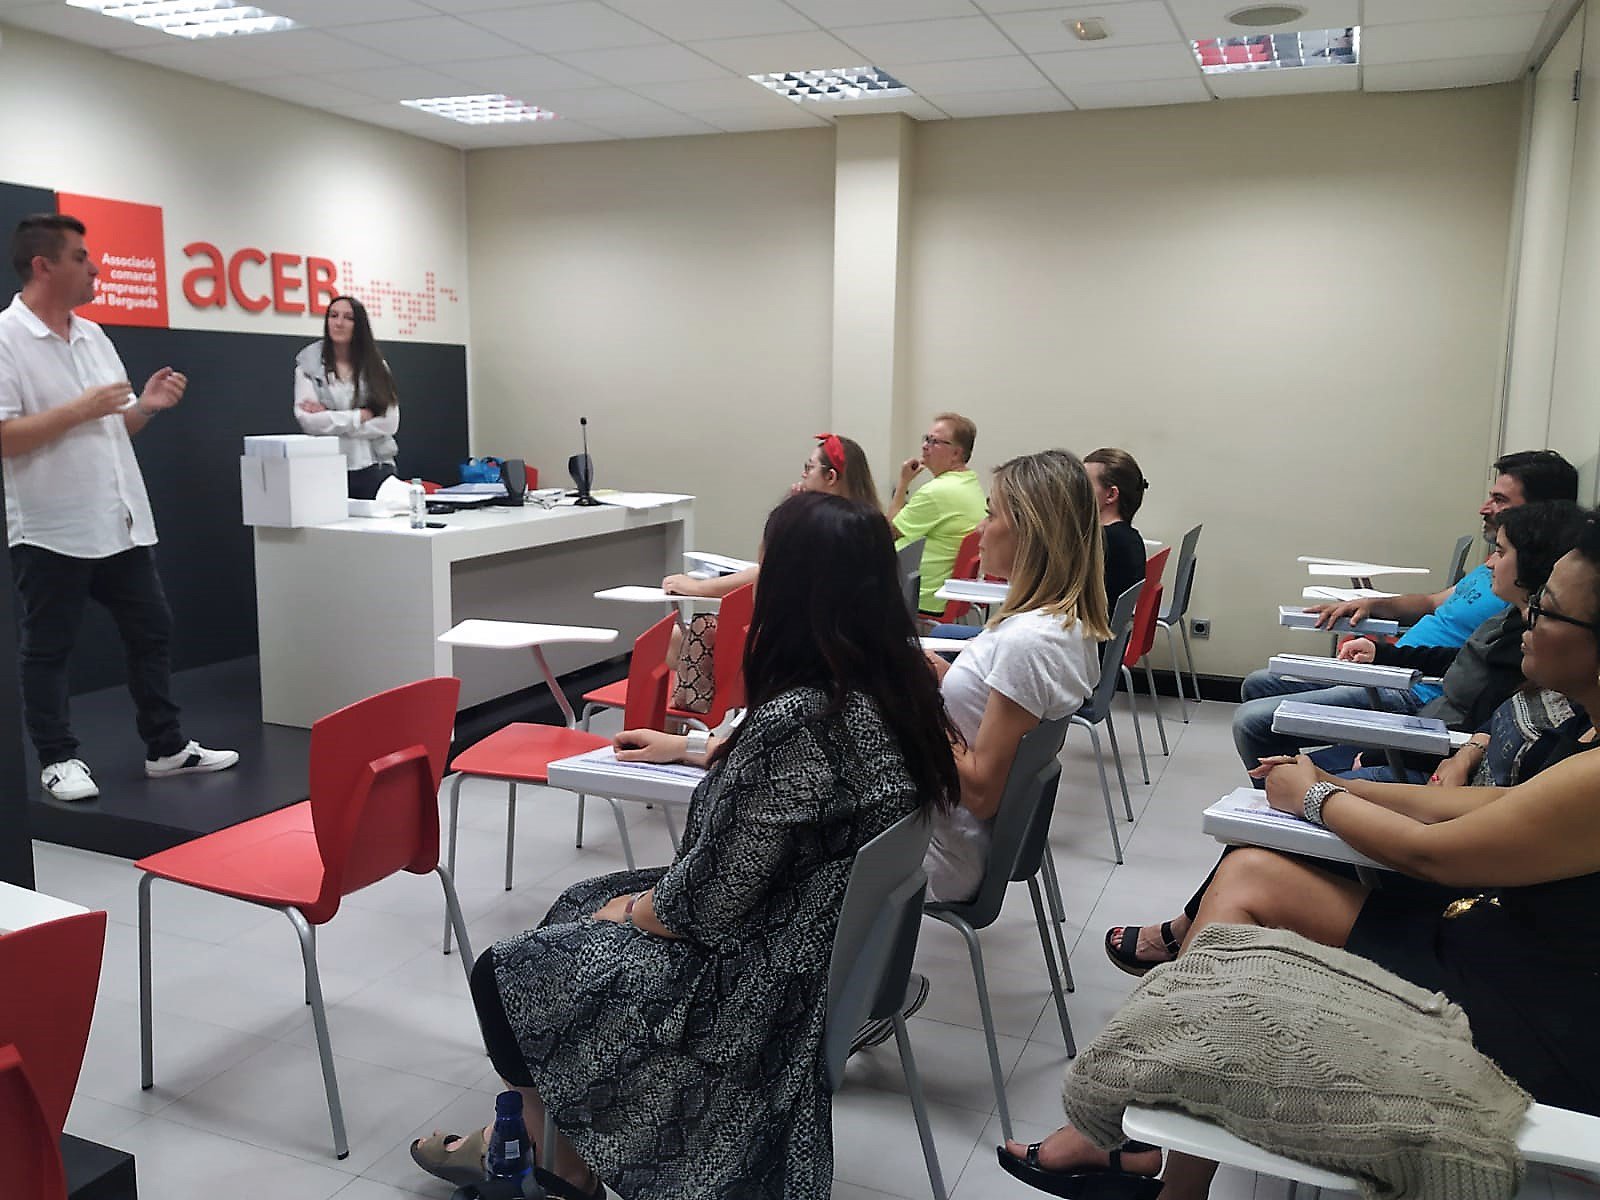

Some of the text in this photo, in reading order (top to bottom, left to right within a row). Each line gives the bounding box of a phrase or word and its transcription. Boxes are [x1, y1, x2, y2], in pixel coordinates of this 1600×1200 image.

[101, 252, 156, 270] Associació
[110, 269, 157, 283] comarcal
[92, 292, 106, 305] el
